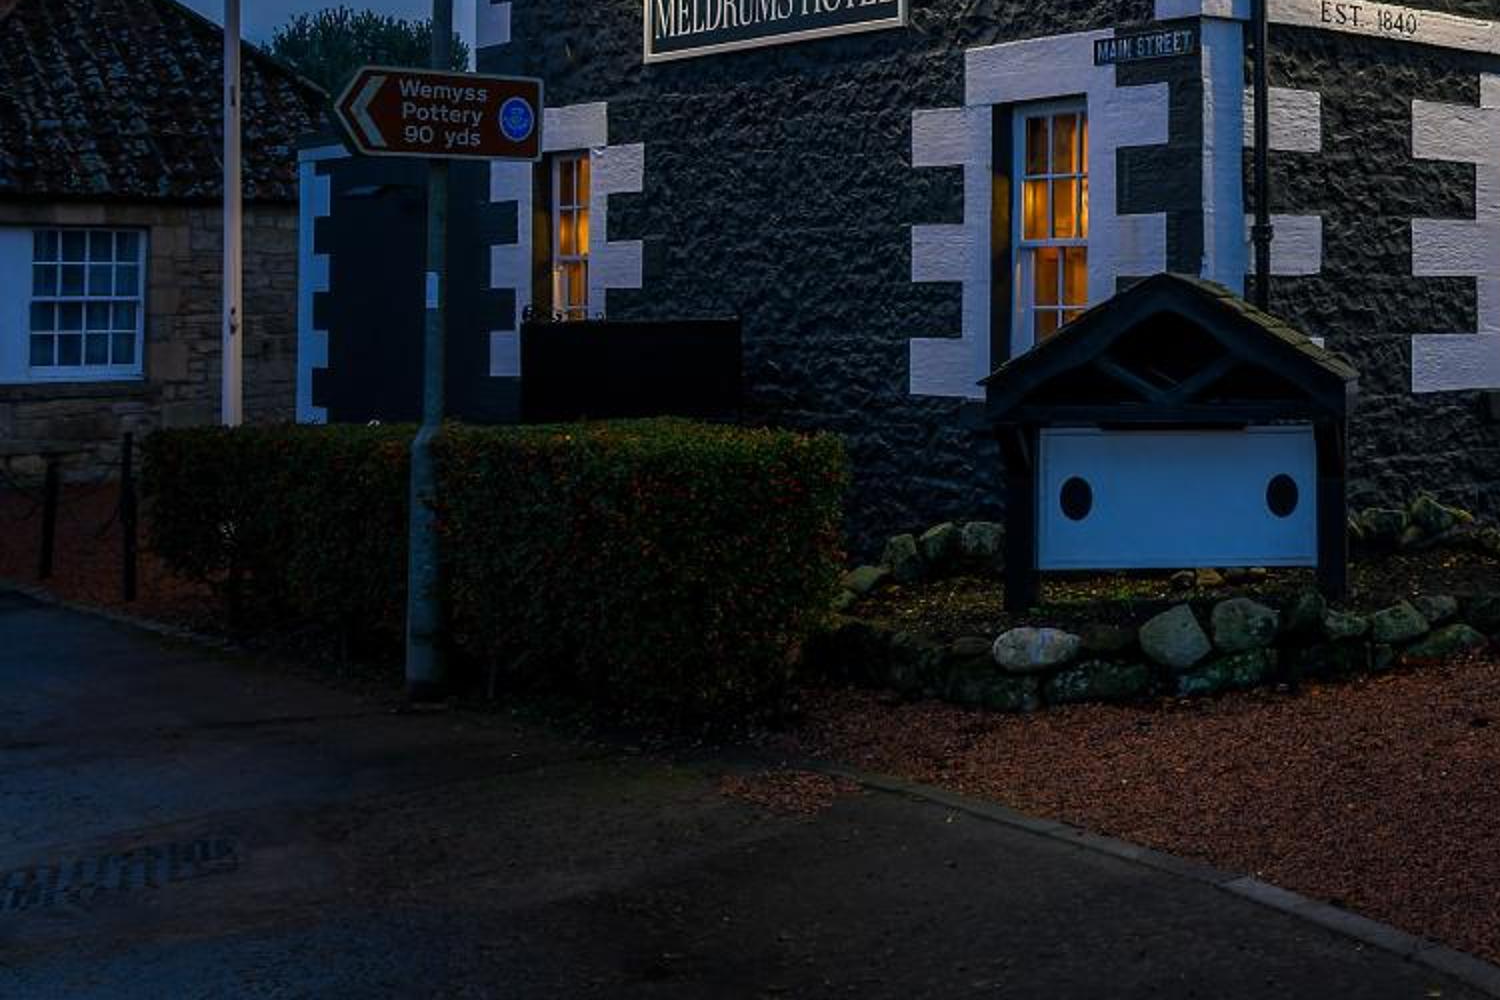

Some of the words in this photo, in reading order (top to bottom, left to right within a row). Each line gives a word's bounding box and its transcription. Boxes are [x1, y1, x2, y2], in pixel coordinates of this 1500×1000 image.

[1376, 9, 1417, 34] 1840
[1097, 39, 1132, 59] MAIN
[1137, 31, 1192, 56] STREET
[399, 79, 488, 102] Wemyss
[402, 101, 483, 127] Pottery
[404, 124, 435, 144] 90
[444, 128, 481, 149] yds
